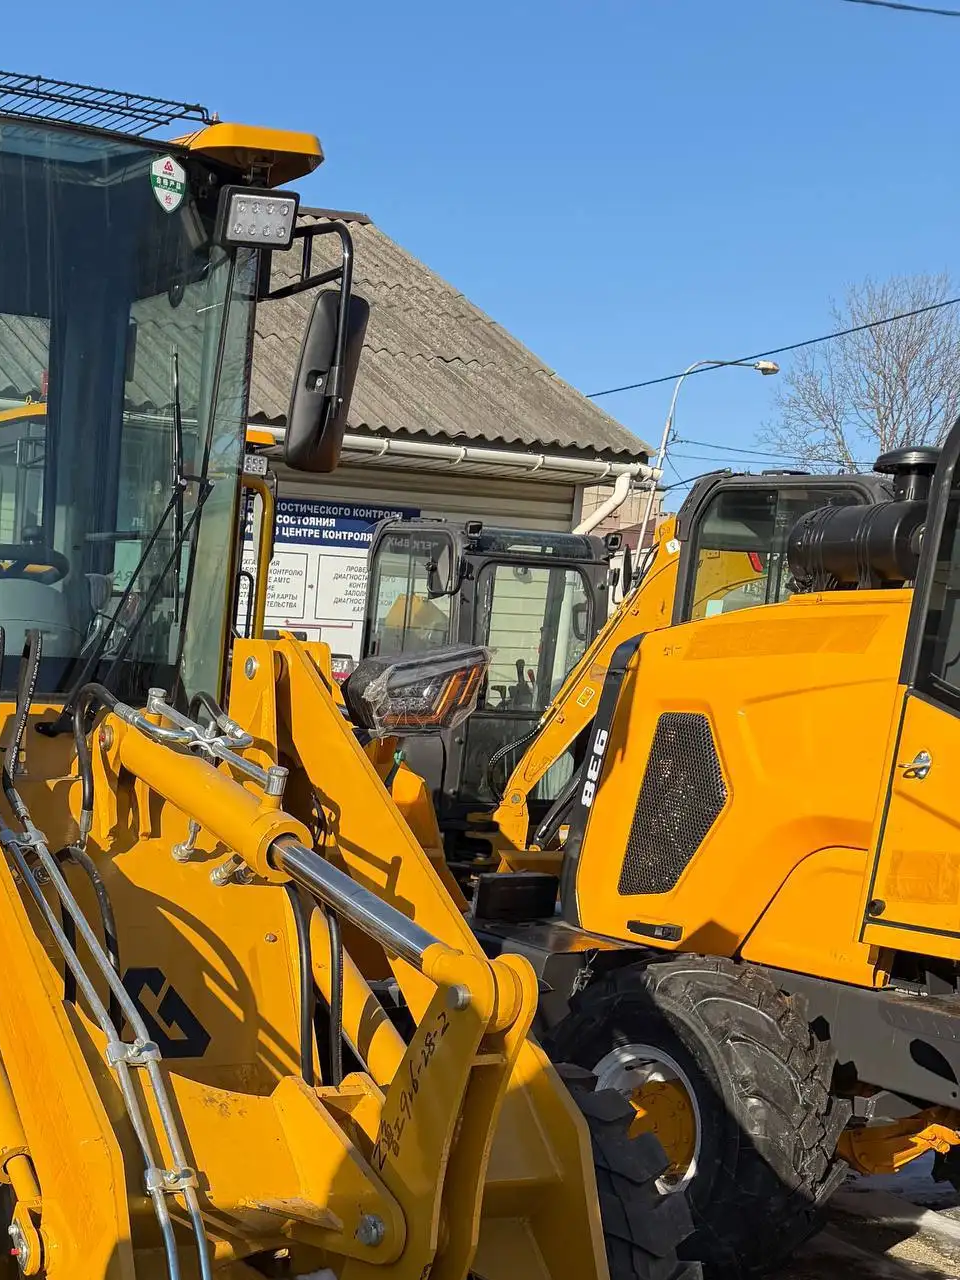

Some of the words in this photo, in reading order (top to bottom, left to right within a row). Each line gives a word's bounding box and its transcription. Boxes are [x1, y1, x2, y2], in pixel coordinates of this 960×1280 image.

[276, 514, 336, 527] СОСТОЯНИЯ
[282, 527, 320, 538] ЦЕНТРЕ
[322, 530, 373, 542] КОНТРОЛЯ
[581, 728, 609, 808] 938
